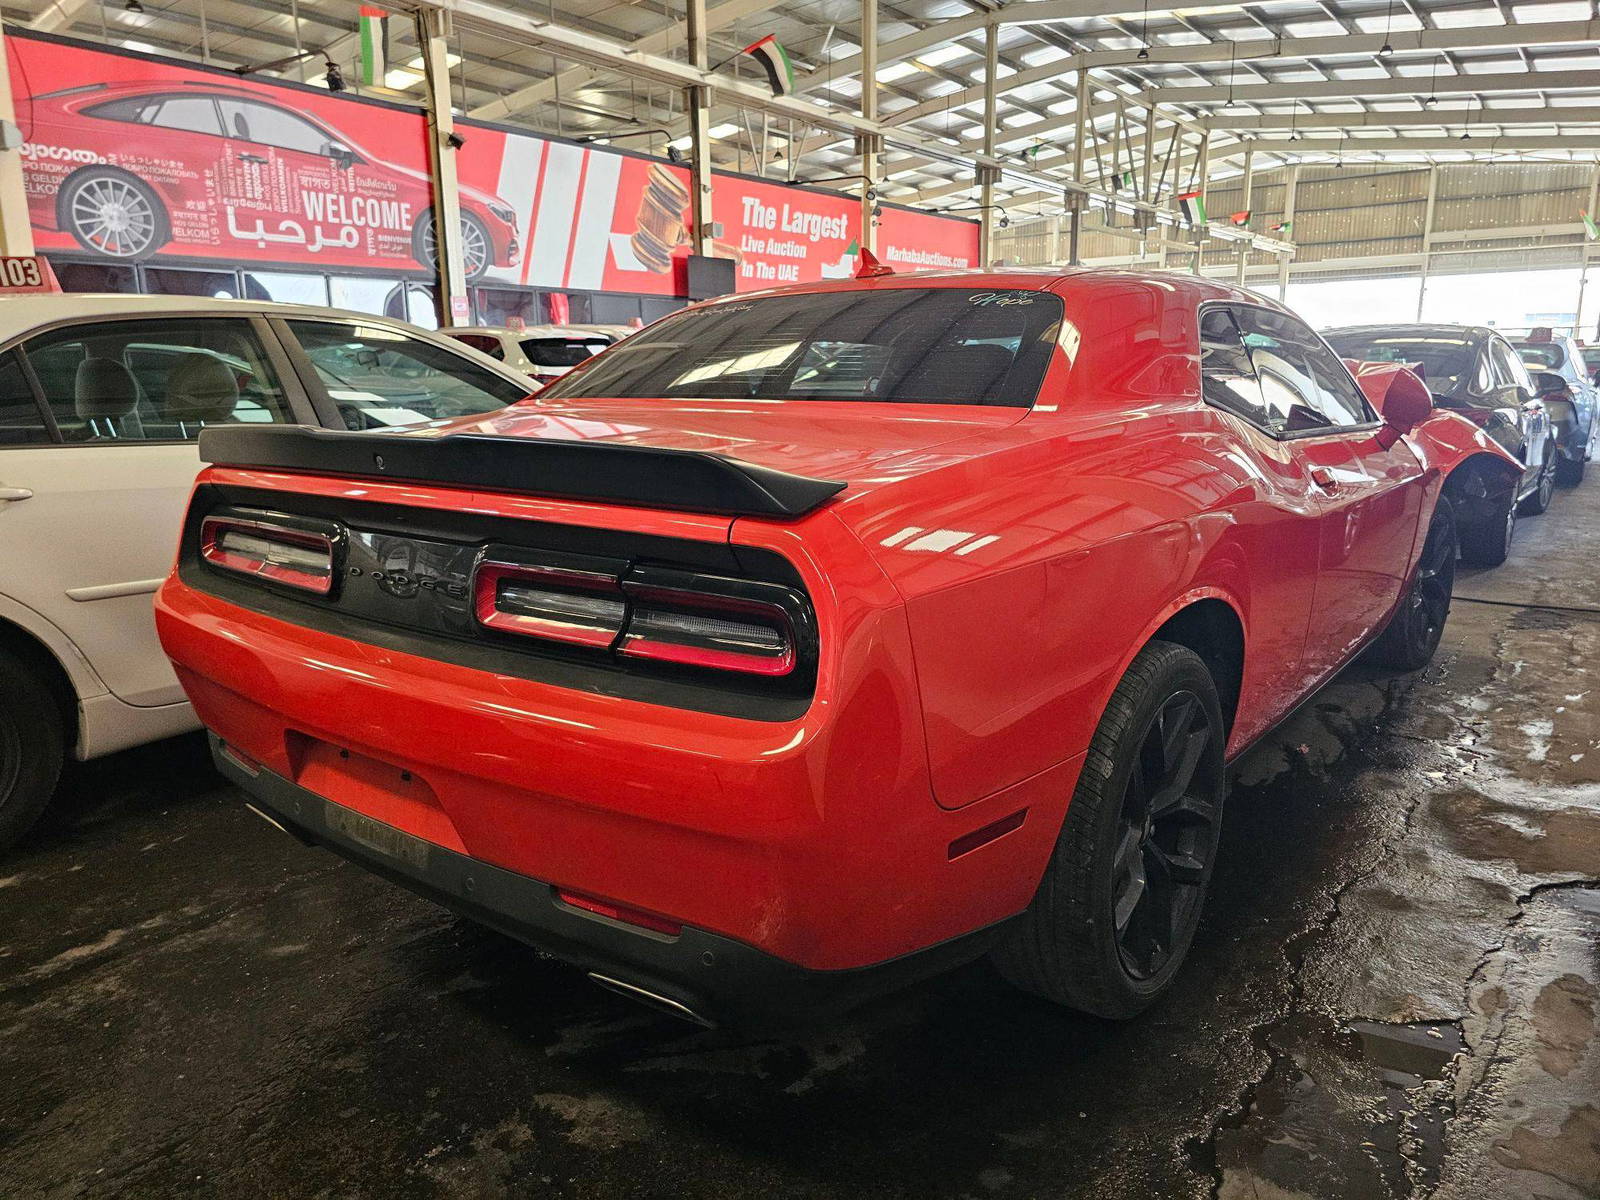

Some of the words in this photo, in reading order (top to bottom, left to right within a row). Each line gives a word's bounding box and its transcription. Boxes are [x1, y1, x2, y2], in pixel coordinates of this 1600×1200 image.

[301, 189, 413, 232] WELCOME
[742, 196, 776, 230] The
[781, 203, 848, 242] Largest
[226, 205, 359, 252] مرحبا
[741, 234, 765, 254] Live
[766, 238, 807, 258] Auction
[886, 245, 968, 269] MarhabaAuctions.com
[742, 261, 754, 278] In
[756, 261, 776, 280] The
[778, 264, 800, 281] UAE
[349, 566, 464, 596] DODGE
